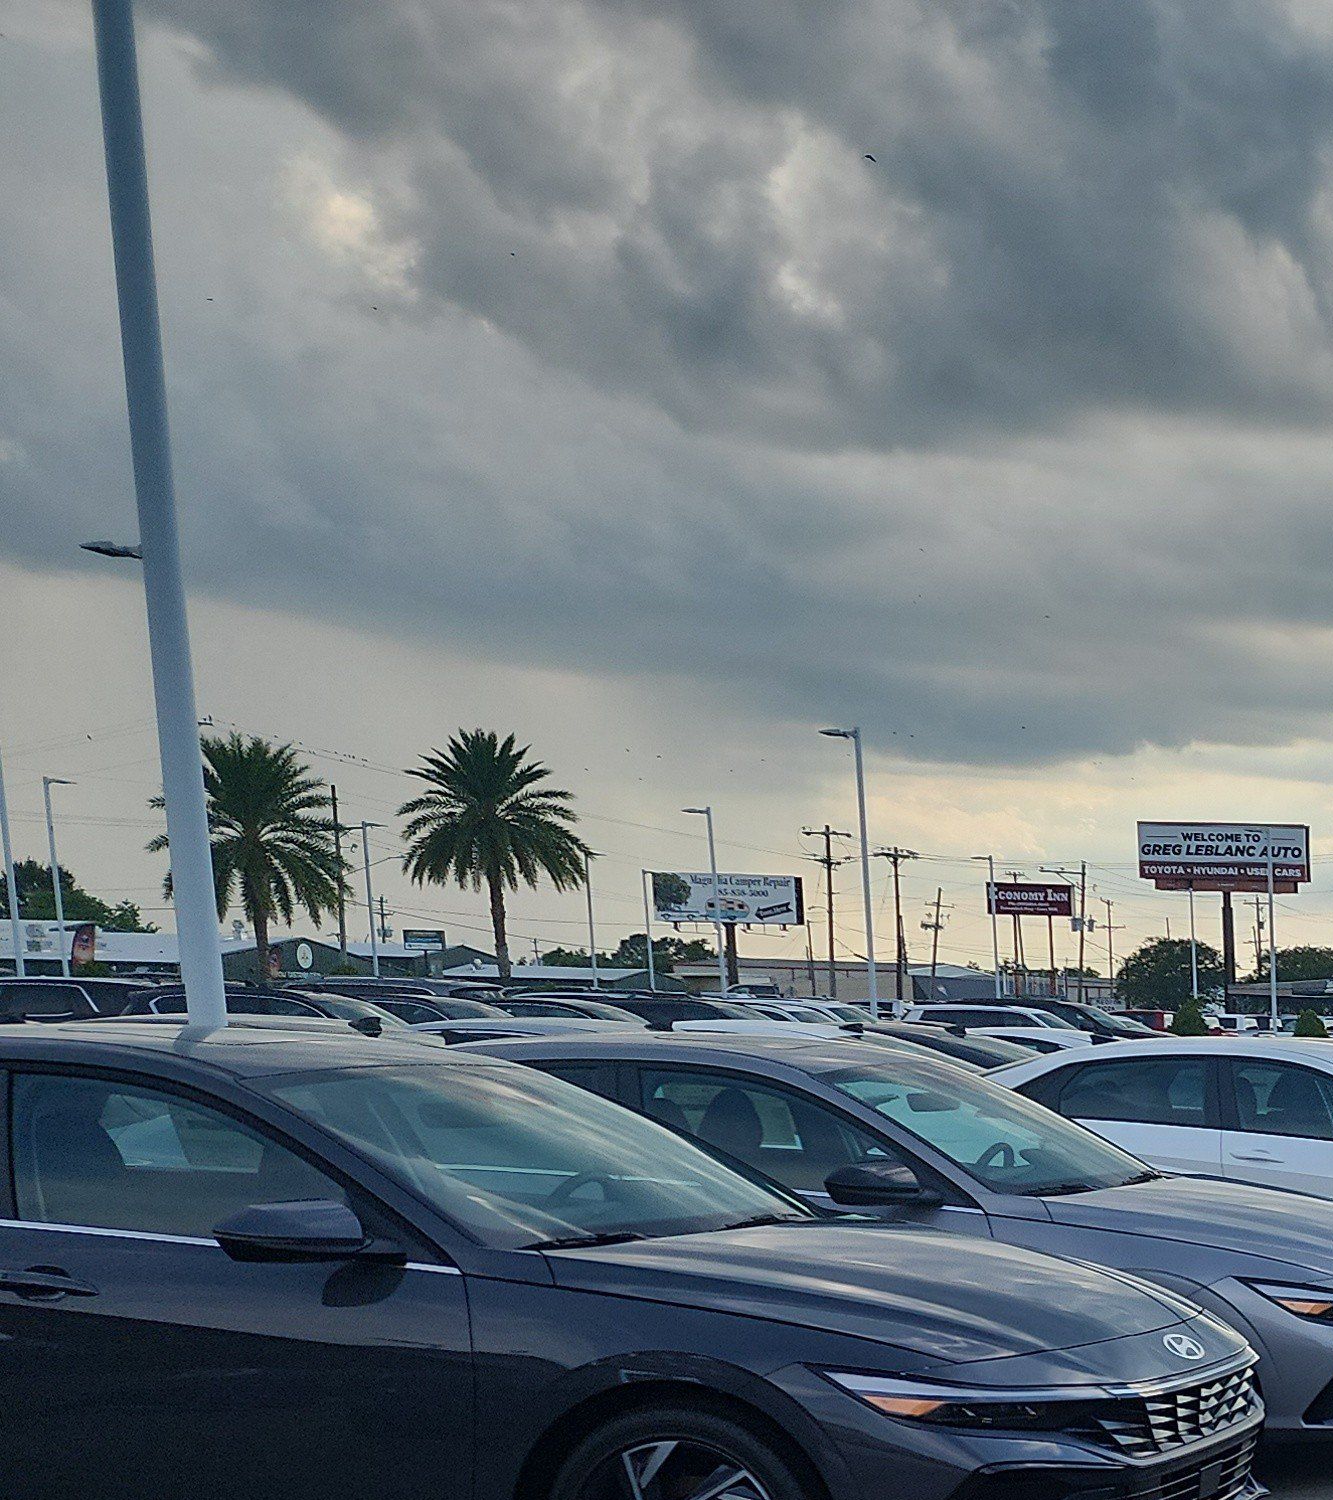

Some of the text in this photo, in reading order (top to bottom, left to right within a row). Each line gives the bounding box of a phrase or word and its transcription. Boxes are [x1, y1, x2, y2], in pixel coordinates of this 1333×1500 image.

[1181, 832, 1262, 843] WELCOME TO
[1141, 843, 1302, 858] GREG LEBLANC AUTO
[1143, 865, 1185, 875] TOYOTA
[1193, 867, 1239, 876] HYUNDAI
[1274, 868, 1301, 877] CARS
[690, 874, 728, 888] Magnlia
[763, 877, 791, 890] Repair
[1046, 888, 1069, 902] INN
